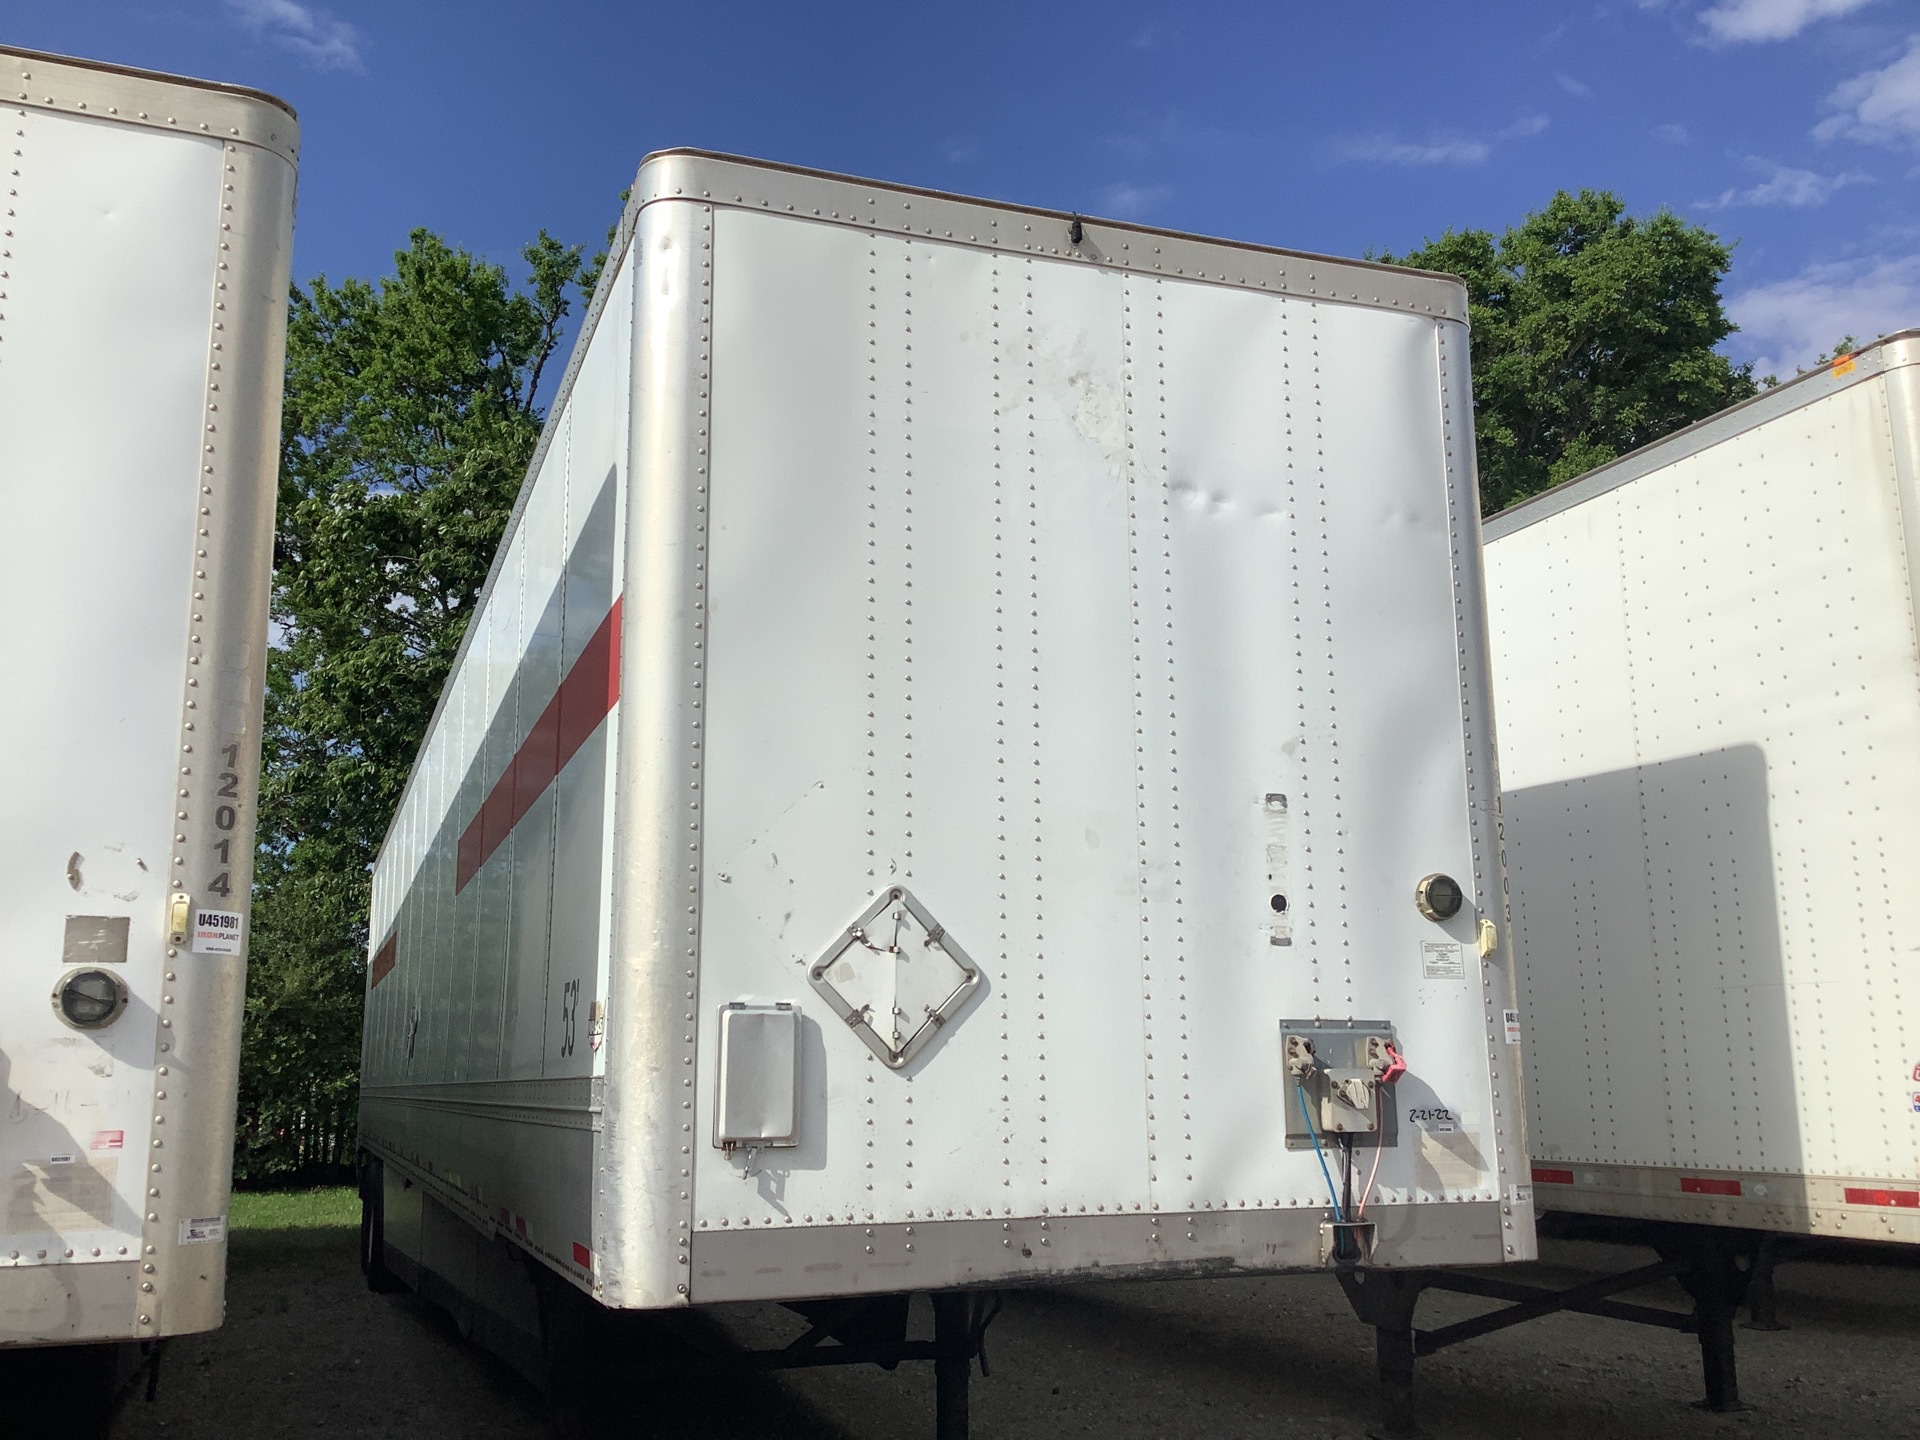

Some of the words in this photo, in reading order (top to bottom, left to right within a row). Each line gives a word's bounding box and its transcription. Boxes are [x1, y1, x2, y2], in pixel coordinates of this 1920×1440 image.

[207, 743, 241, 899] 12014
[1497, 795, 1512, 922] 12003
[198, 913, 239, 930] U451981
[1409, 1108, 1454, 1124] 2-21-22
